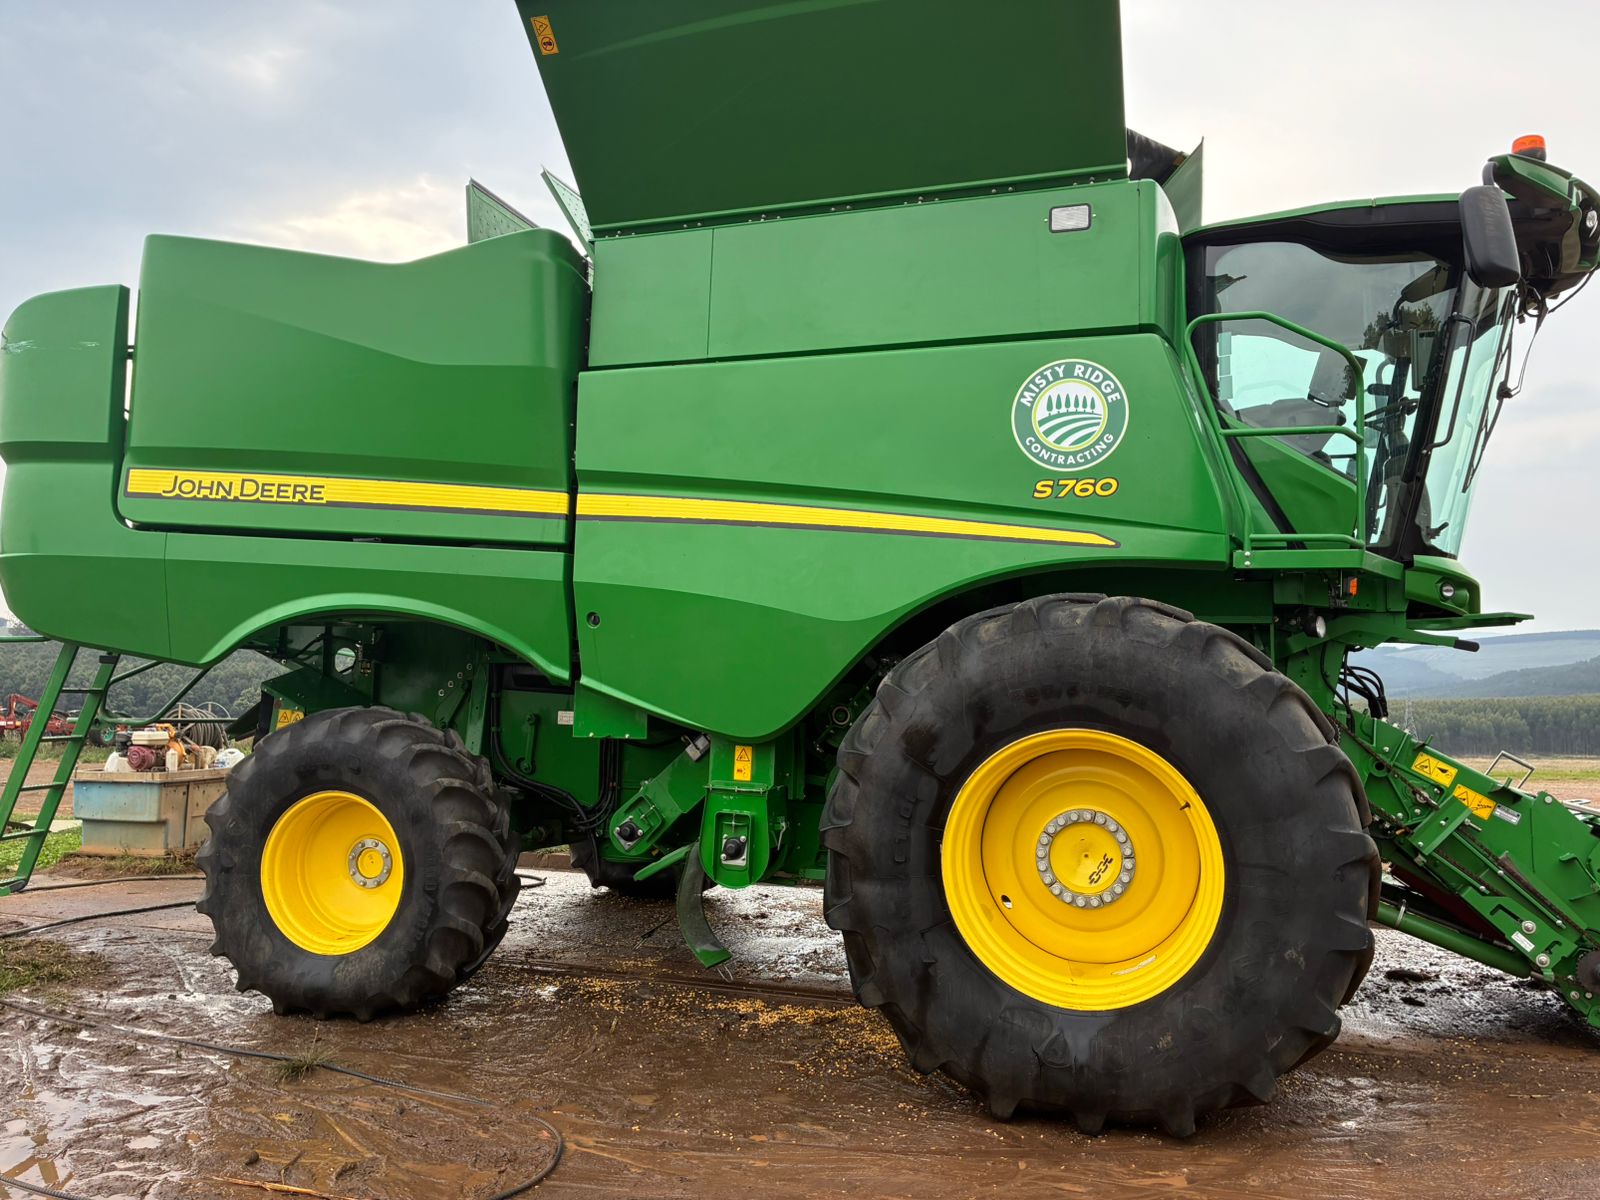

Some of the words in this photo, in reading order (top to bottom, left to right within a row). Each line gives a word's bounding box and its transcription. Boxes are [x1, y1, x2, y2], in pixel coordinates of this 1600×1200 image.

[1020, 364, 1066, 407] MISTY
[1074, 364, 1121, 403] RIDGE
[1025, 433, 1114, 465] CONTRACTING
[162, 475, 233, 497] JOHN
[240, 478, 325, 501] DEERE
[1032, 476, 1119, 499] S760
